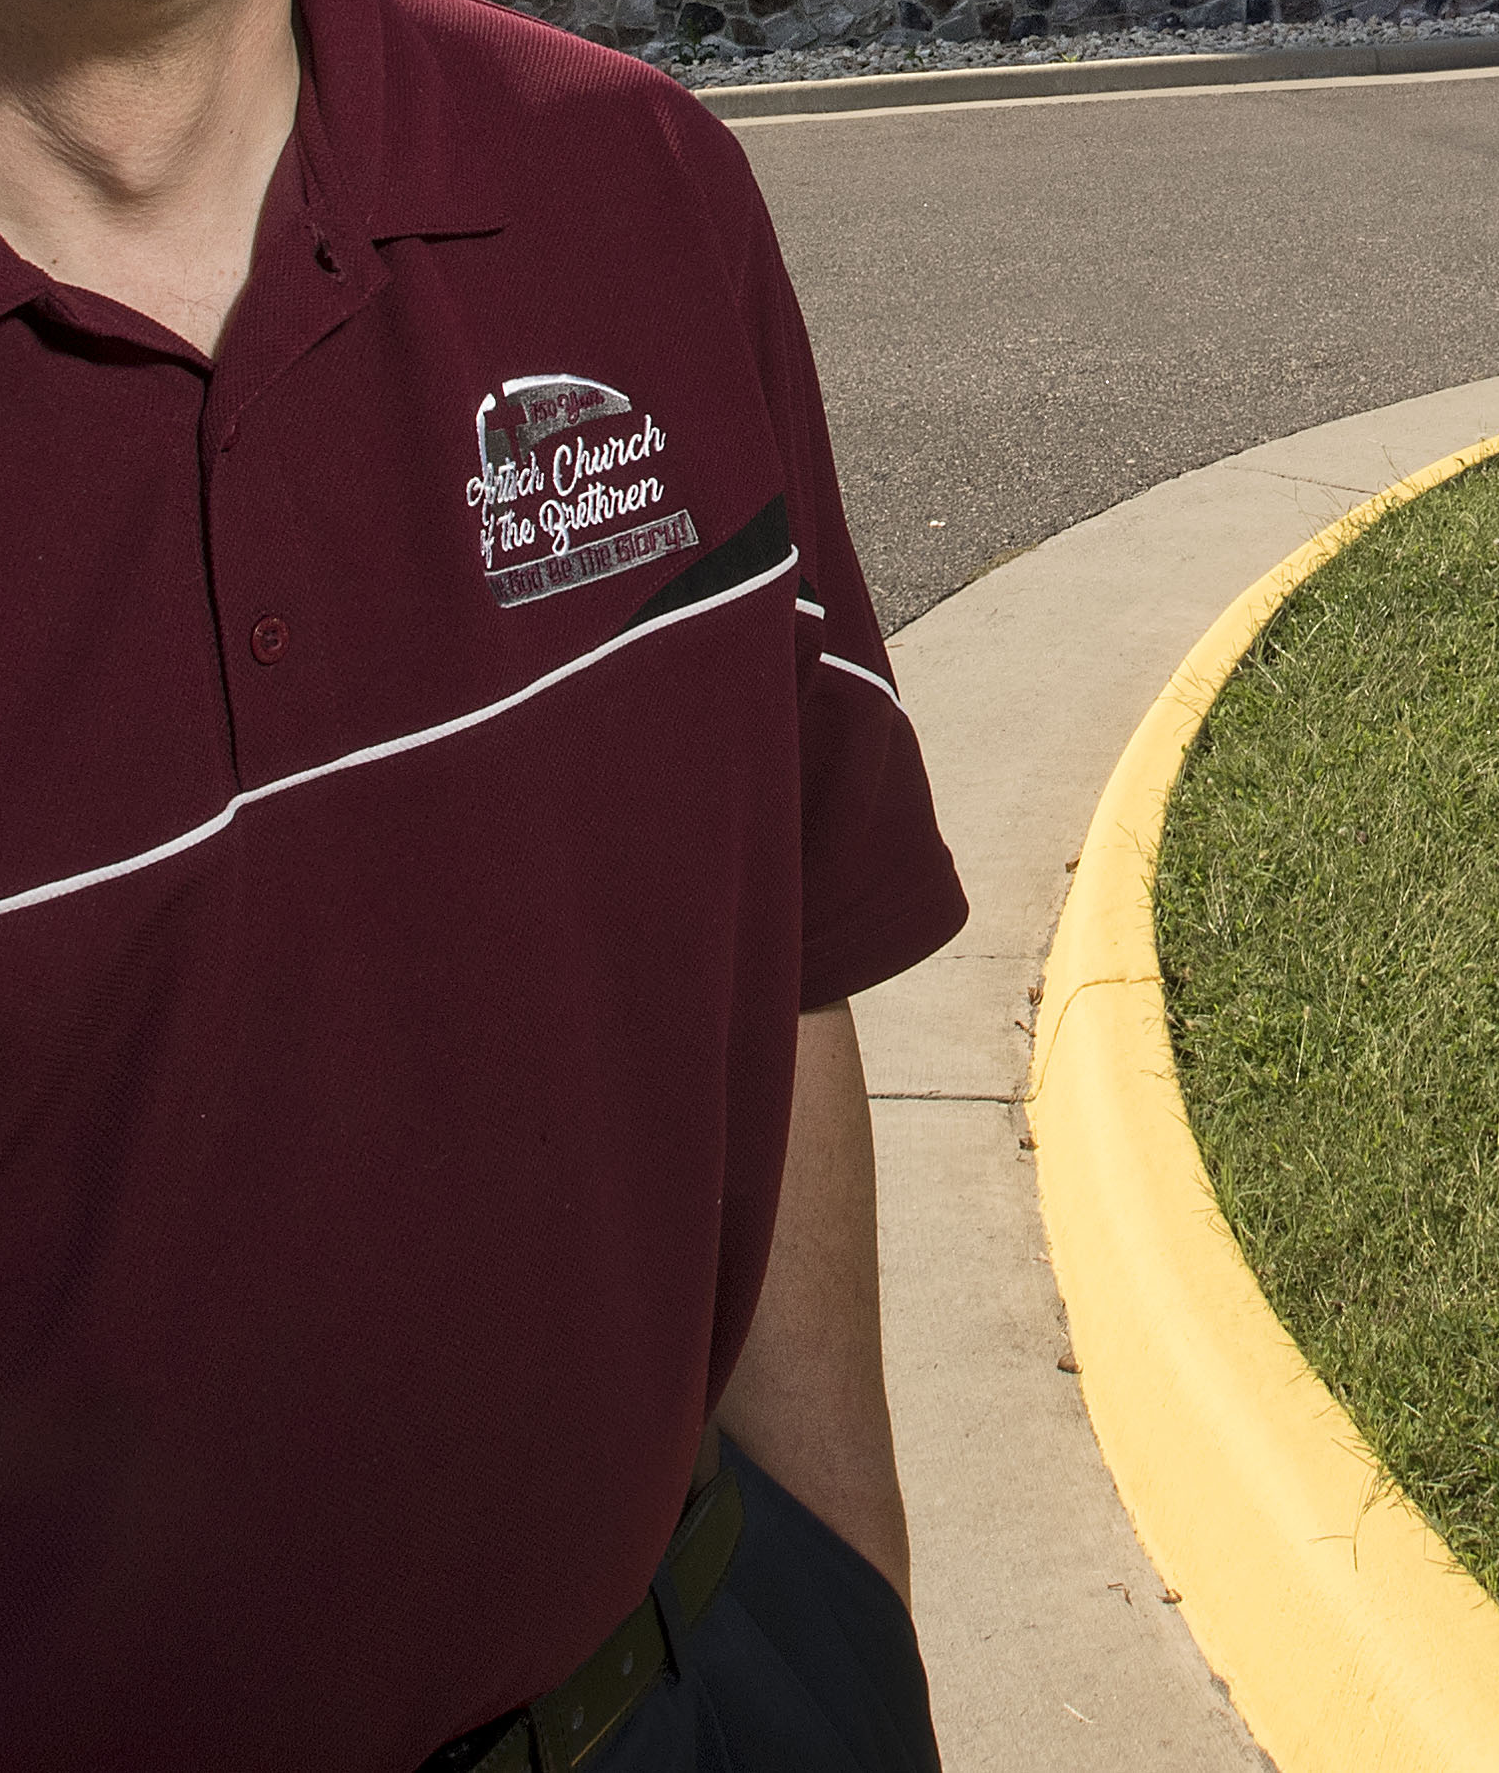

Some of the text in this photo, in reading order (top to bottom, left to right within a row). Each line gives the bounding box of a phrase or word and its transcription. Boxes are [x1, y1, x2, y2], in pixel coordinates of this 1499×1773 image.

[466, 413, 667, 508] Antch Church
[497, 508, 537, 553] the
[538, 475, 665, 558] Brethren
